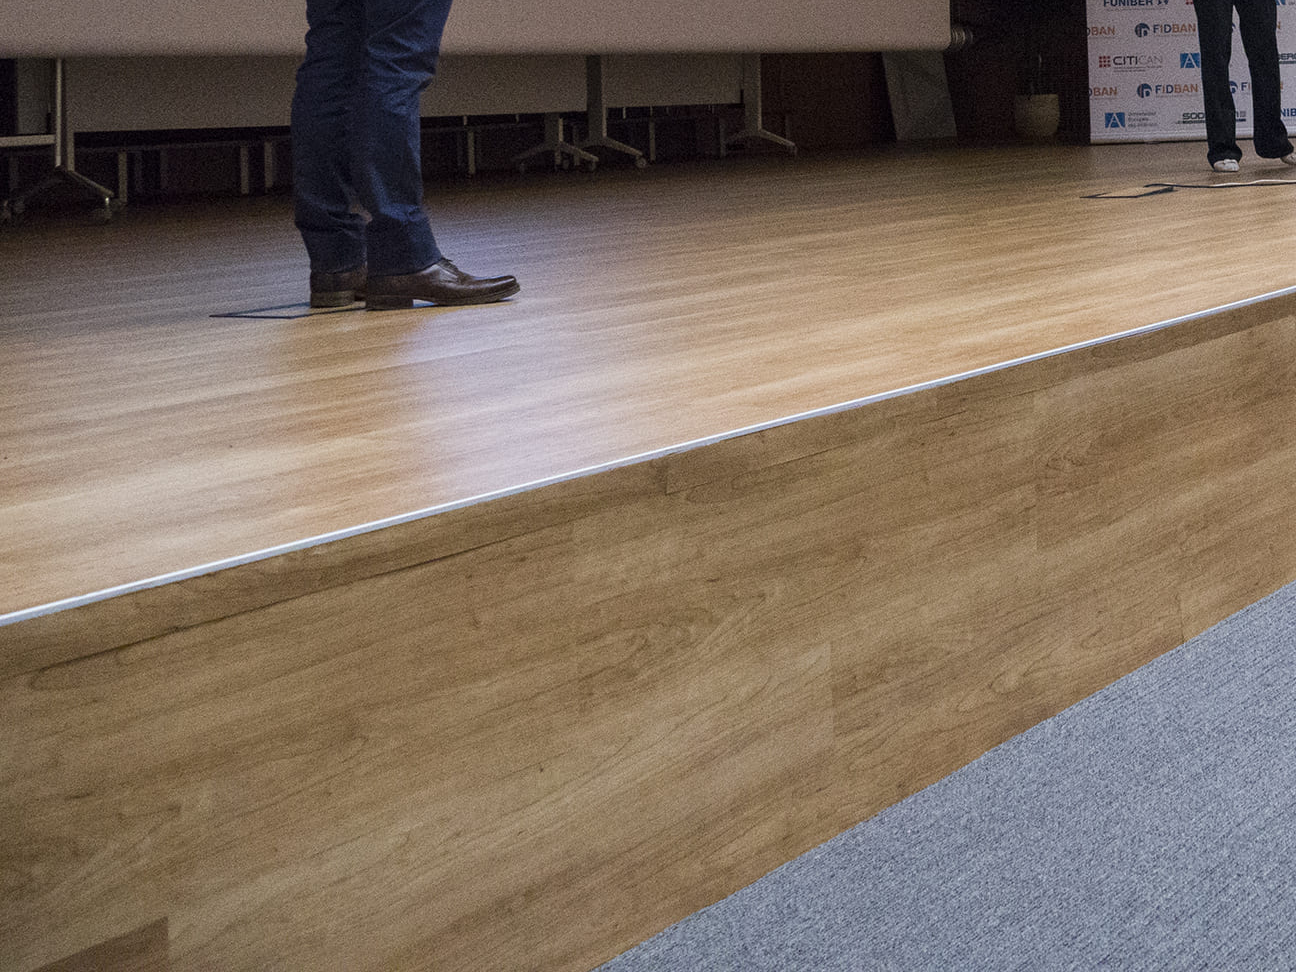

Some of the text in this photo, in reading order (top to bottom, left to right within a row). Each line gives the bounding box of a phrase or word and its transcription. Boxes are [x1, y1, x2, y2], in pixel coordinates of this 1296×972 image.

[1153, 23, 1197, 33] FIDBAN
[1112, 55, 1163, 66] CITICAN
[1155, 84, 1199, 94] FIDBAN
